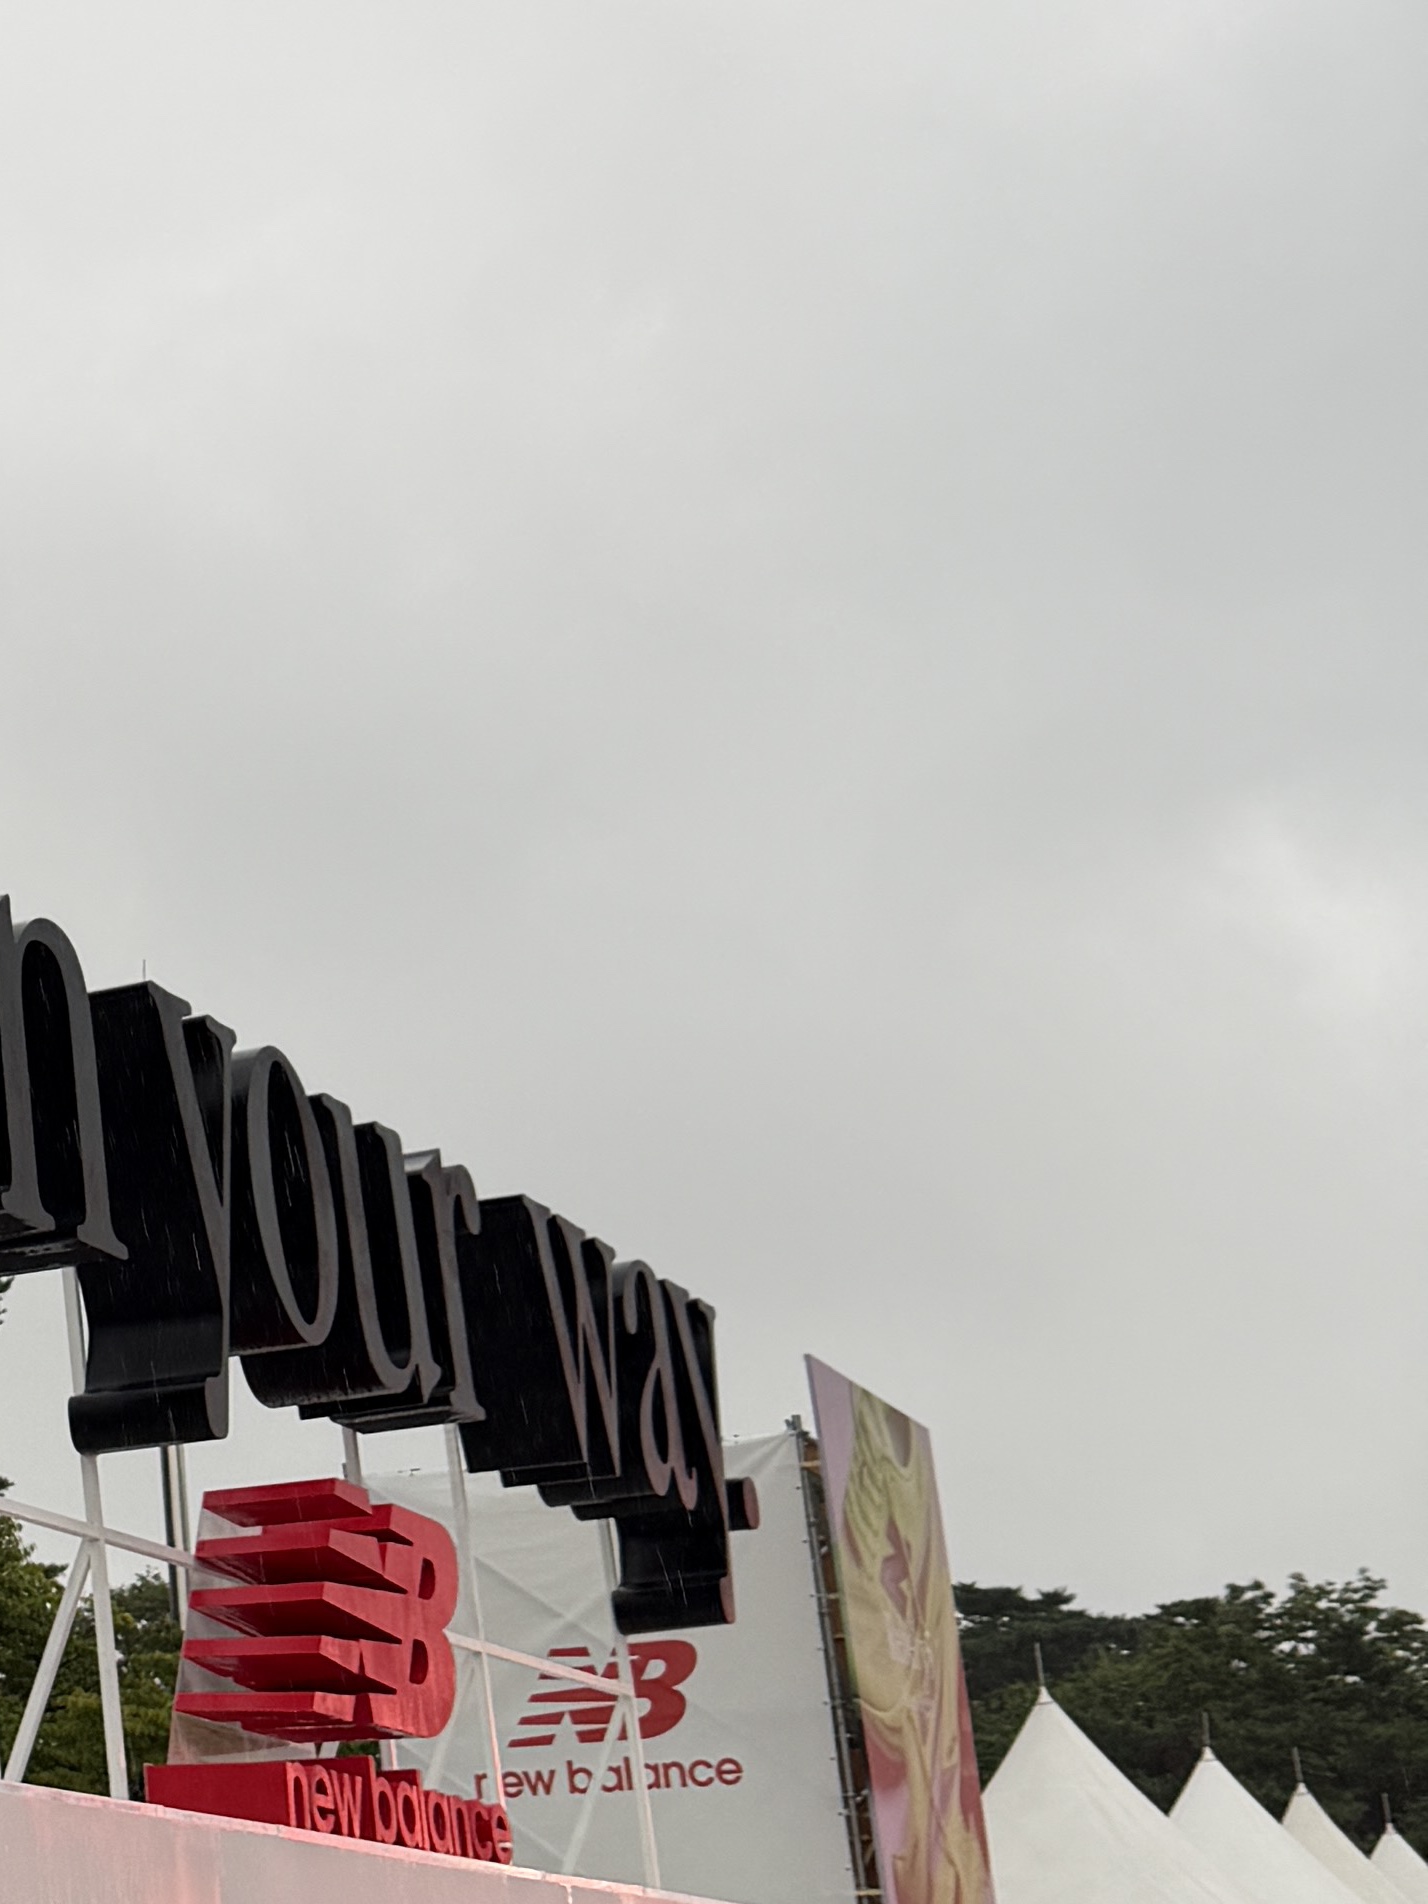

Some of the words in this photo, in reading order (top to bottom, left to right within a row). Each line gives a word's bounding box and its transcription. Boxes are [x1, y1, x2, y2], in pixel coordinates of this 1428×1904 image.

[68, 979, 487, 1455] your
[285, 1759, 363, 1840] new
[367, 1754, 514, 1866] balance
